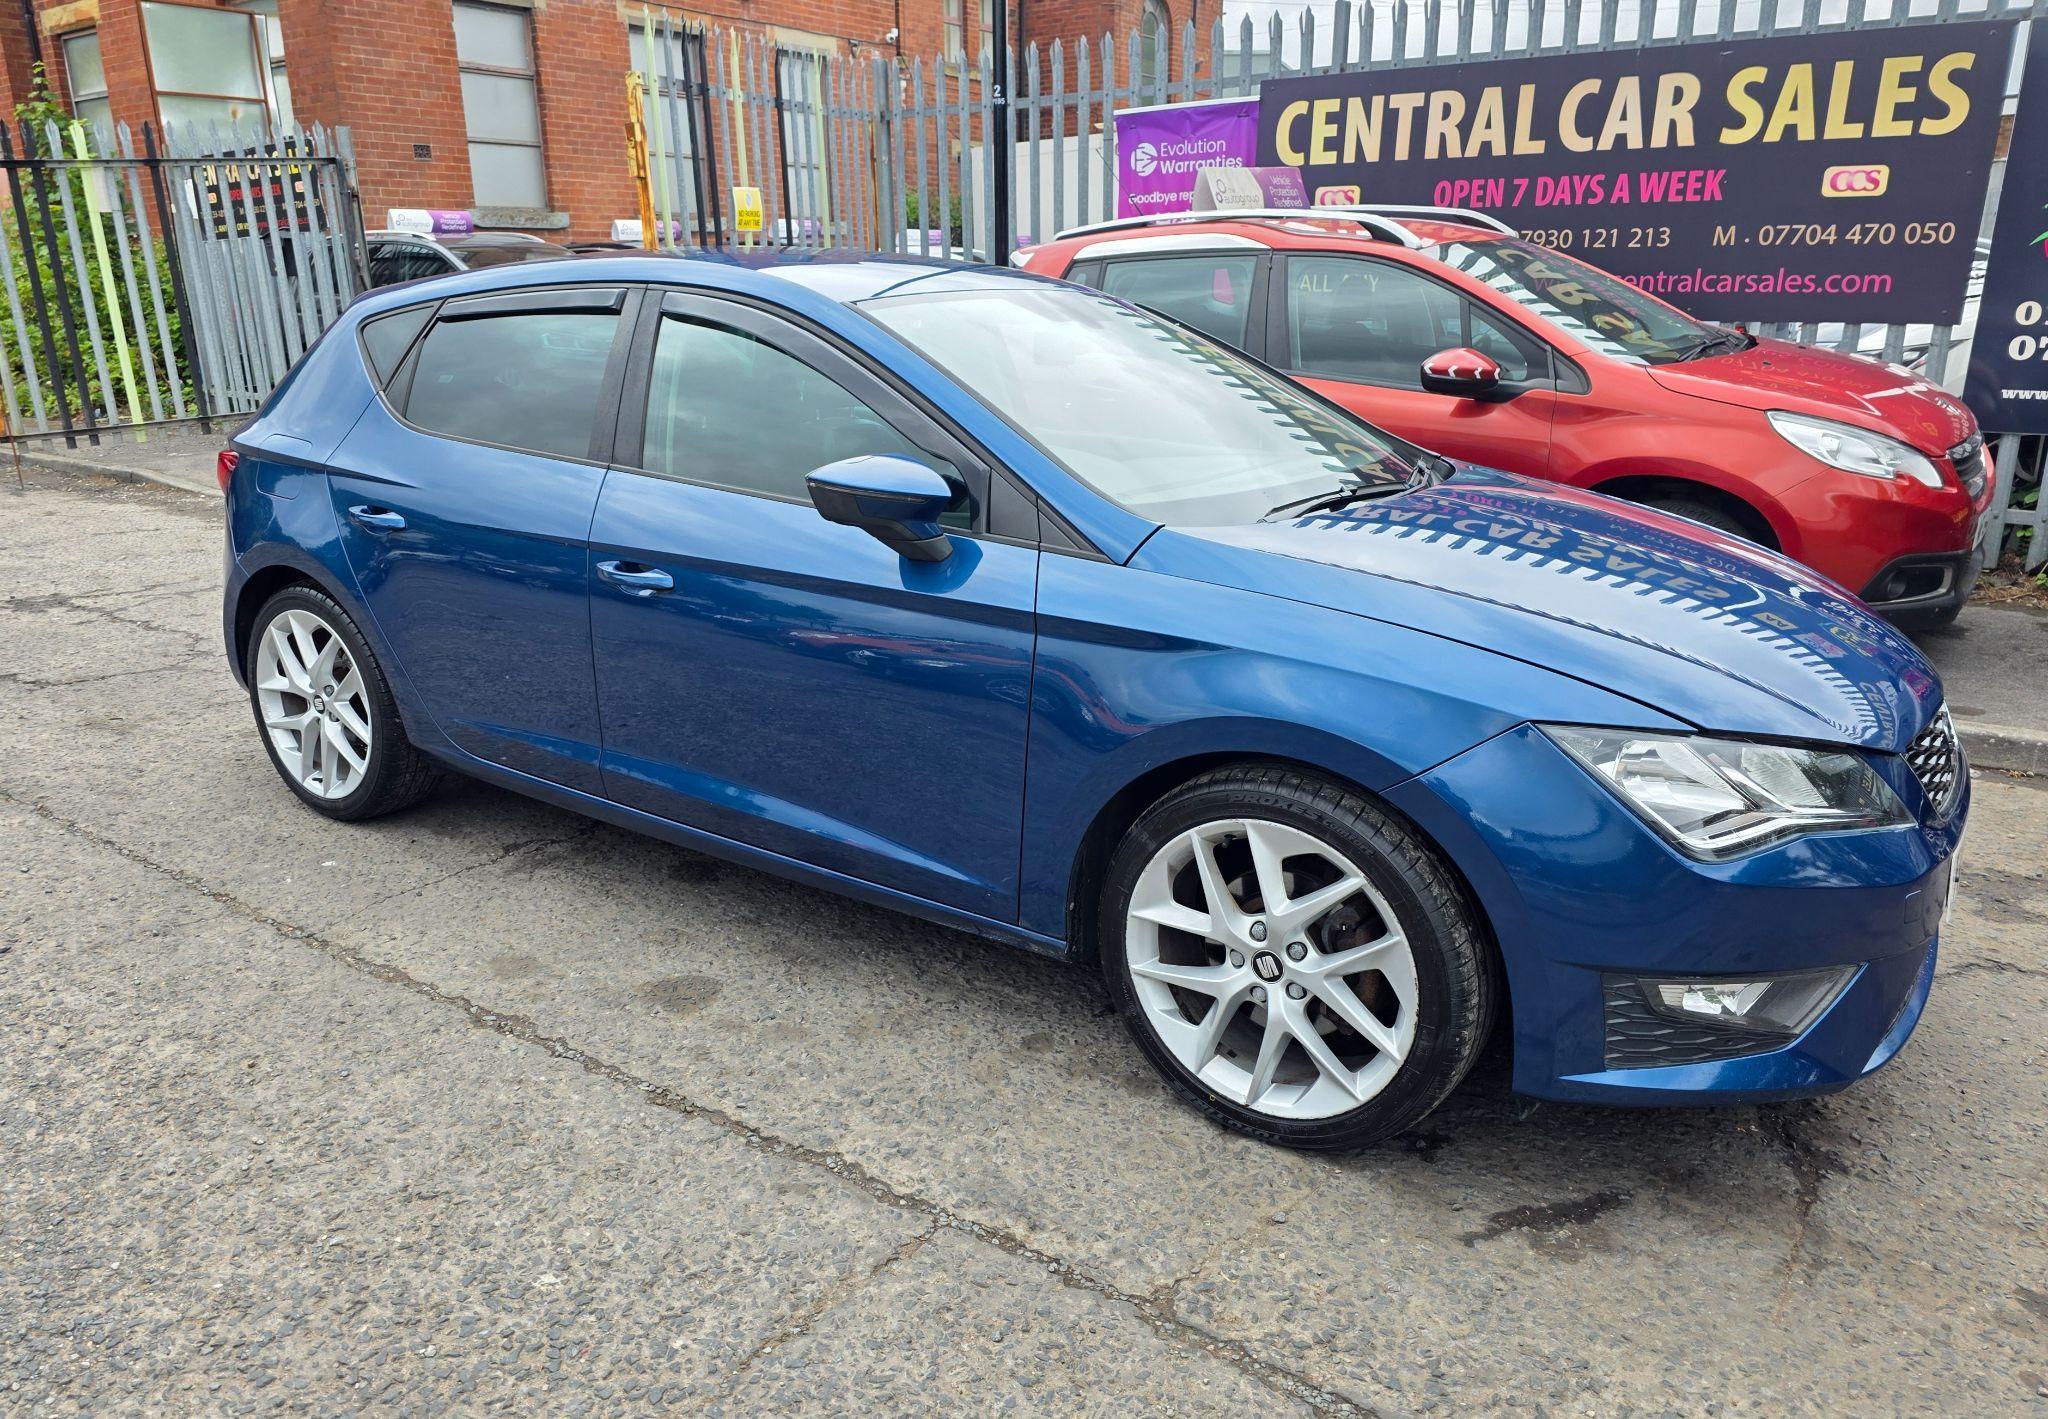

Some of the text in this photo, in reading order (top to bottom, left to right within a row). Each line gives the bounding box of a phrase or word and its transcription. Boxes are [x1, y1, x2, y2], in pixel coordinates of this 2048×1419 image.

[1275, 51, 1976, 167] CENTRAL CAR SALES
[1161, 139, 1226, 157] Evolution
[1160, 155, 1243, 174] Warranties
[1434, 169, 1726, 208] OPEN 7 DAYS A WEEK
[1830, 169, 1882, 193] CCS
[1128, 191, 1177, 206] Goodbye
[738, 209, 744, 217] NO
[1582, 228, 1617, 248] 121
[1628, 227, 1671, 248] 213
[1713, 225, 1736, 246] M
[1759, 224, 1837, 246] 07704
[1845, 223, 1896, 245] 470
[1904, 222, 1956, 244] 050
